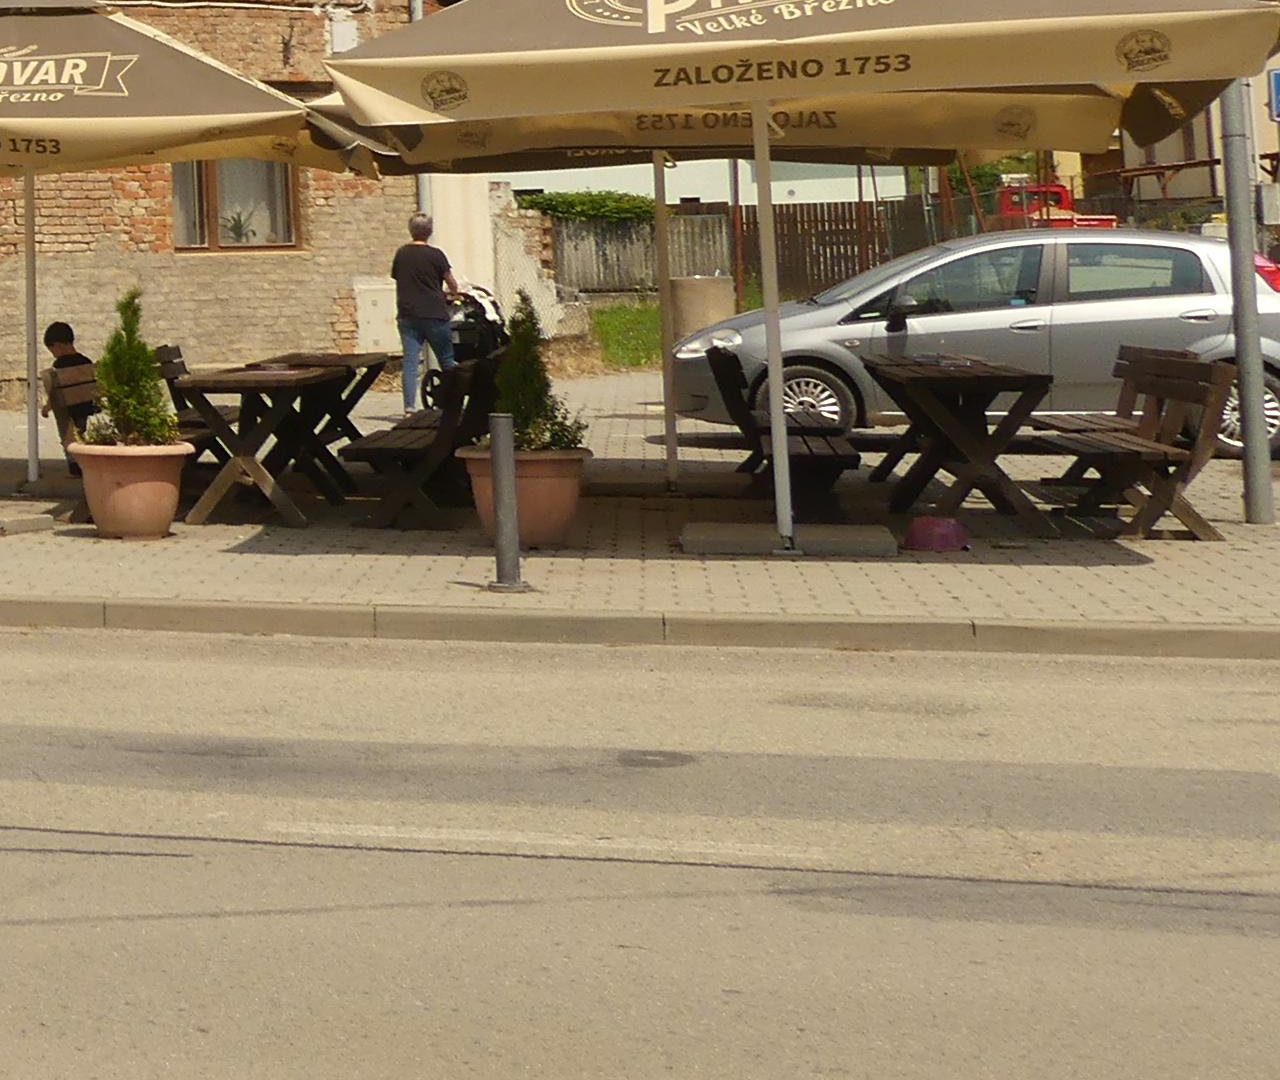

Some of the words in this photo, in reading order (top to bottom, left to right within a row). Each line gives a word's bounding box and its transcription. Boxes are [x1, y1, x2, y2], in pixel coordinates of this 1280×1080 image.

[676, 9, 768, 36] Velké
[653, 58, 825, 88] ZALOŽENO
[835, 53, 912, 77] 1753
[9, 138, 62, 155] 1753
